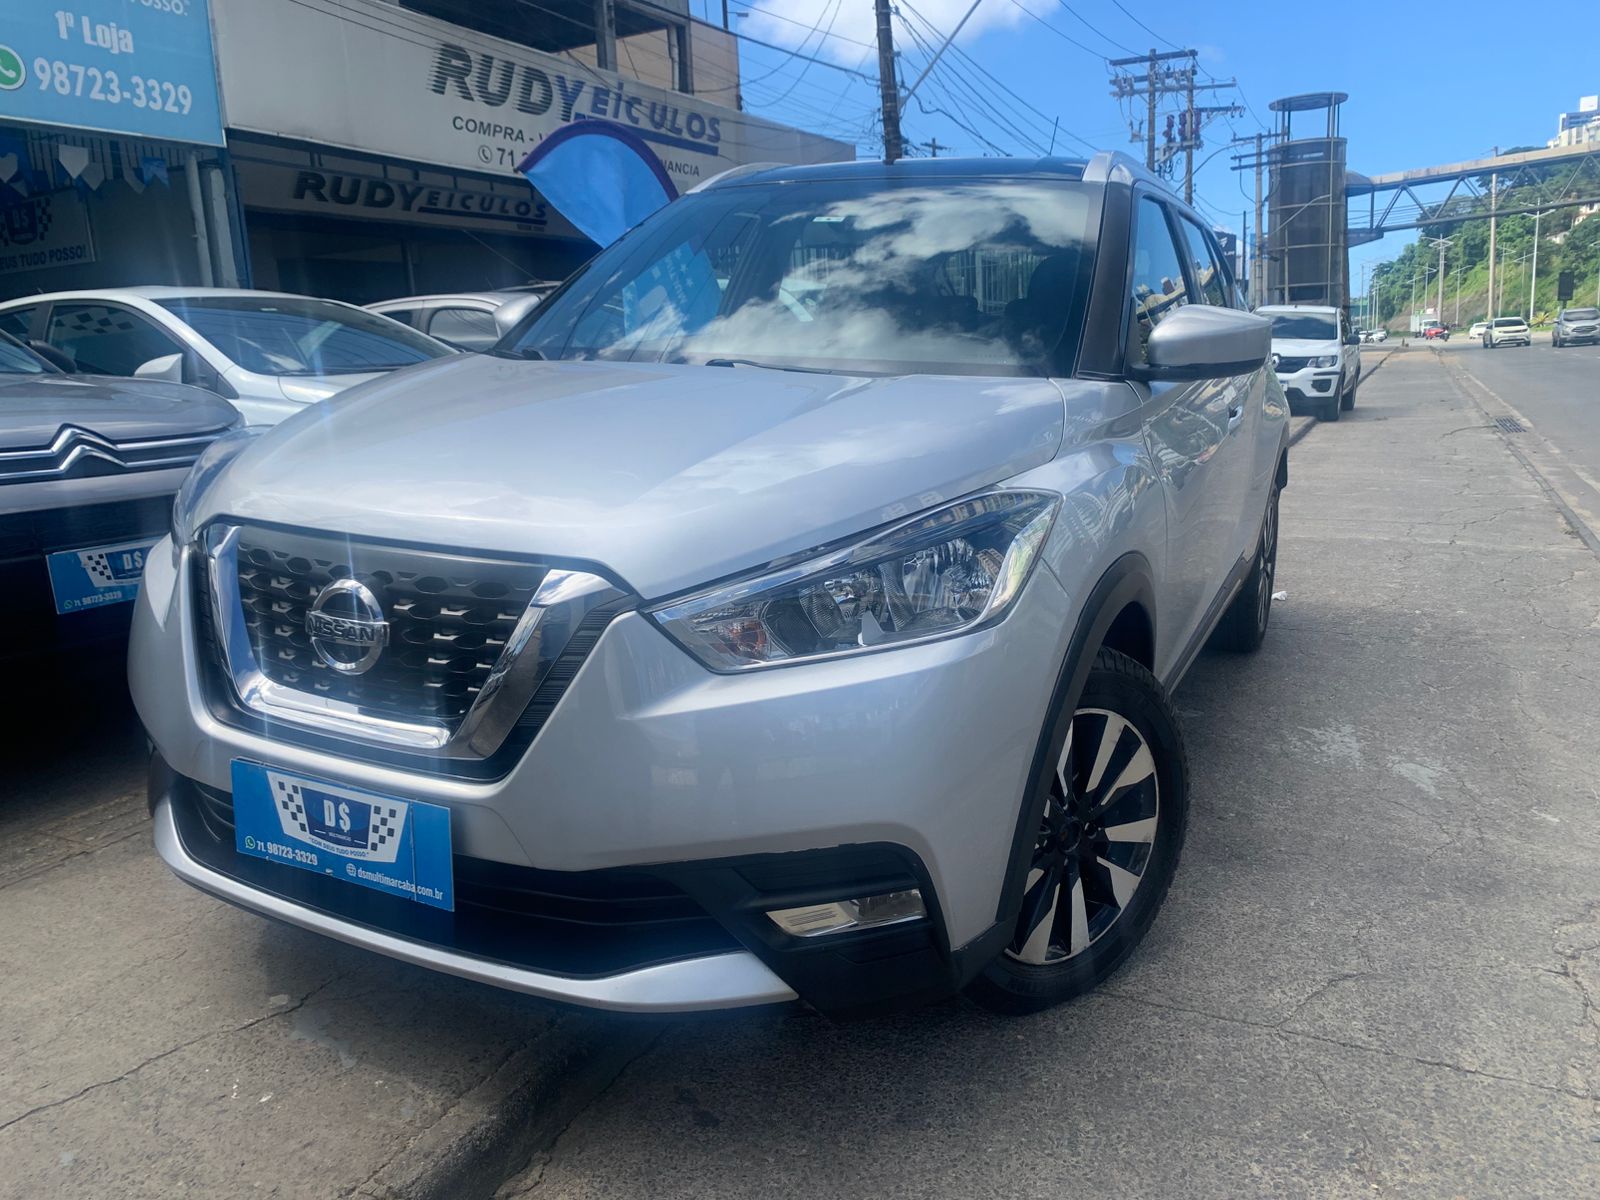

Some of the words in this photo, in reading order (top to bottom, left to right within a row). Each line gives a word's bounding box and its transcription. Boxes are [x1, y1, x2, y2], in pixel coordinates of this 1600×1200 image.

[81, 15, 134, 54] Loja
[33, 56, 193, 115] 98723-3329
[452, 115, 525, 143] COMPRA
[18, 251, 47, 267] TUDO
[308, 614, 377, 641] NISSAN
[267, 841, 318, 866] 98723-3329
